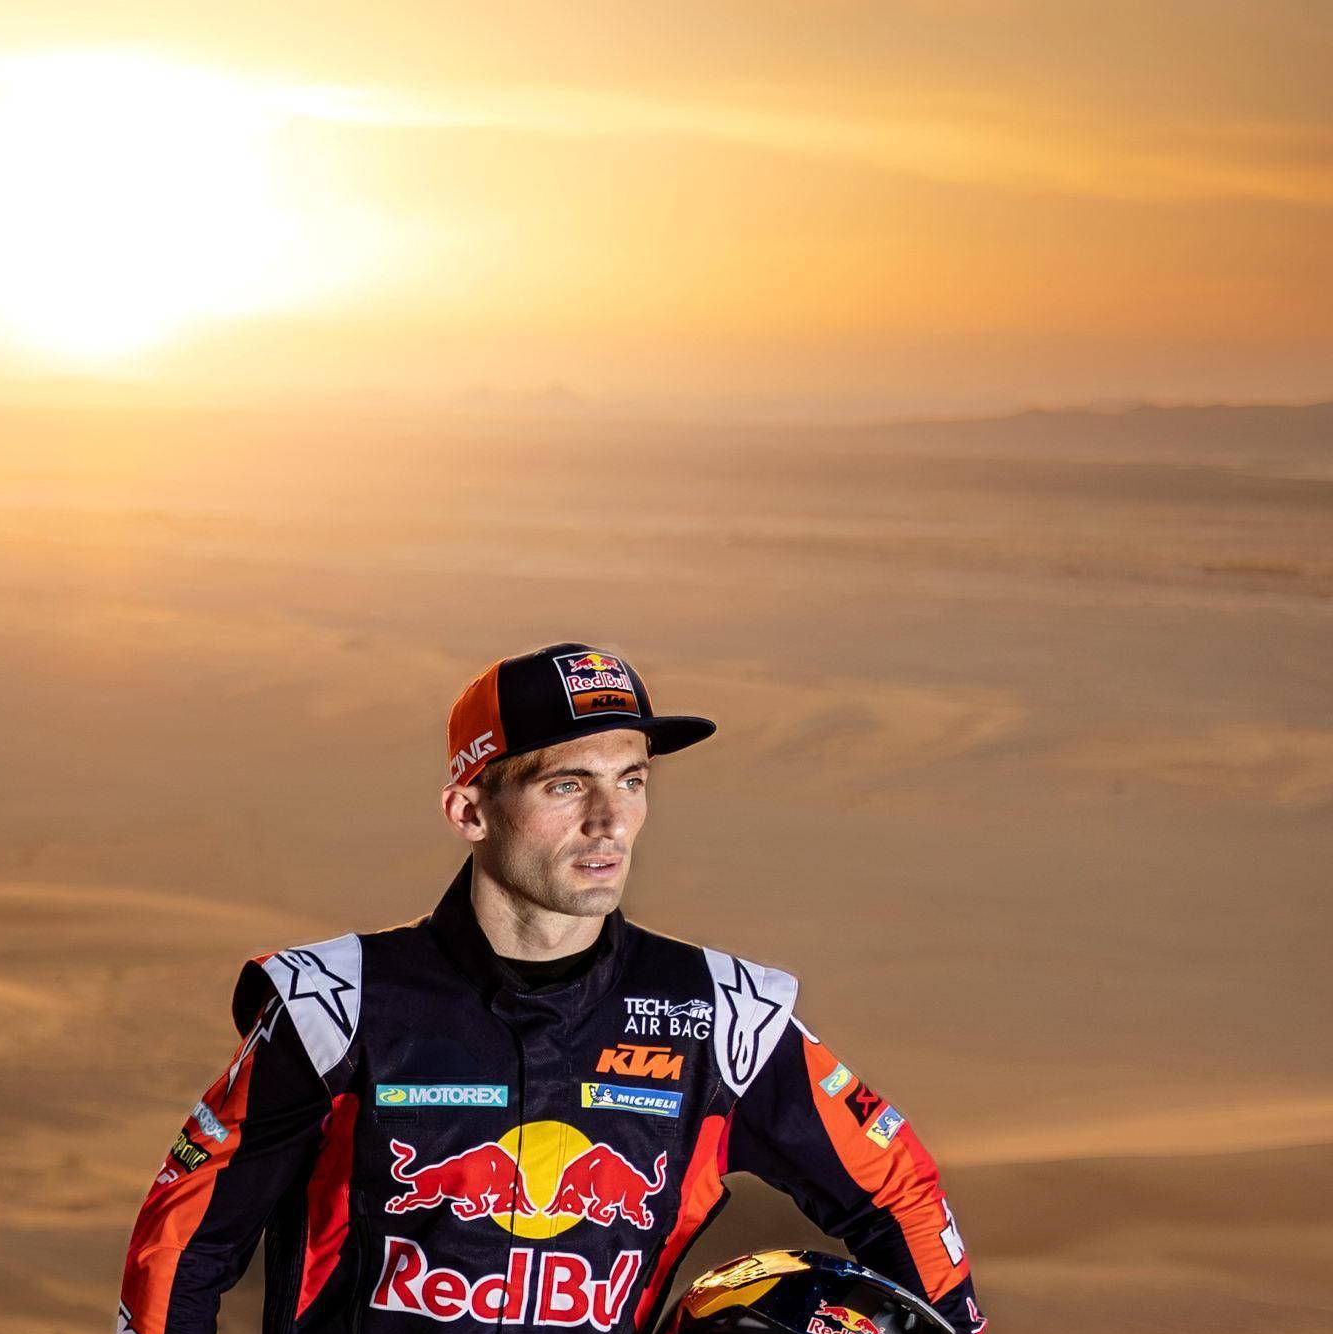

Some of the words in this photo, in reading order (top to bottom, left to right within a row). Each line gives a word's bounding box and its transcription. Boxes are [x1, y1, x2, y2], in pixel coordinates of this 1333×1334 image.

[566, 671, 603, 693] Red
[624, 1016, 661, 1036] AIR
[669, 1017, 711, 1040] BAG
[596, 1043, 685, 1080] KTM
[409, 1087, 503, 1104] MOTOREX
[370, 1236, 534, 1325] Red
